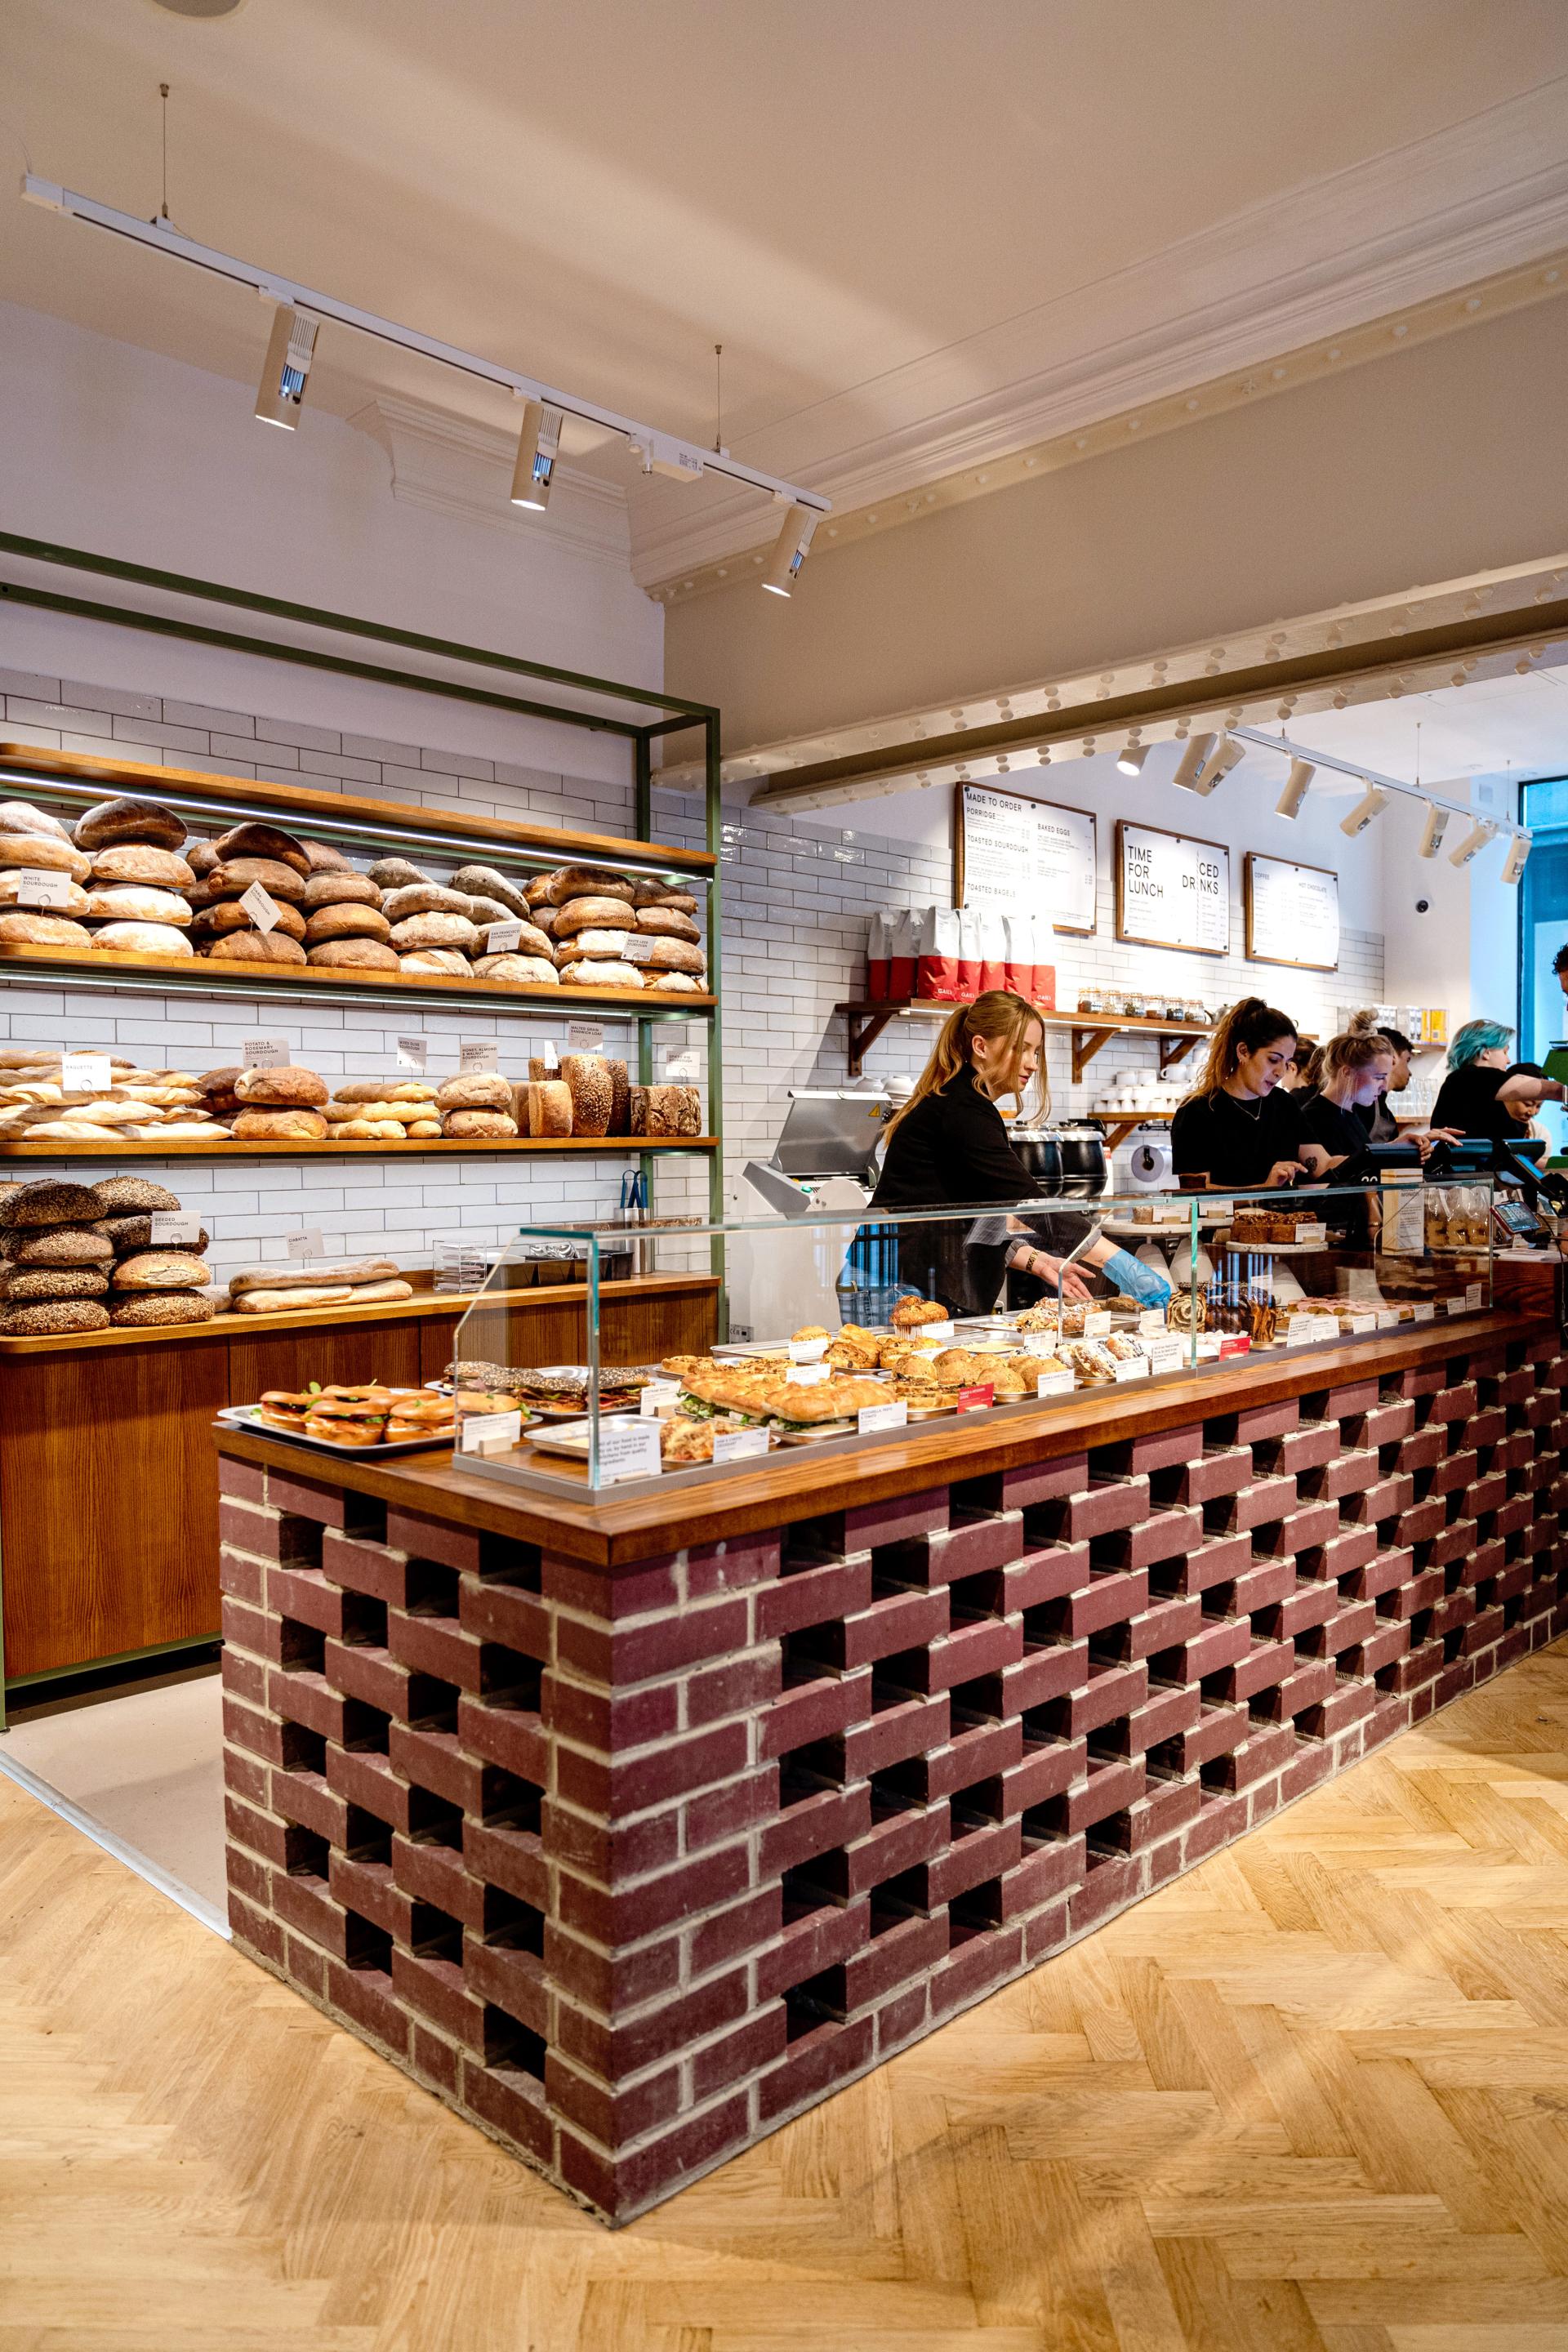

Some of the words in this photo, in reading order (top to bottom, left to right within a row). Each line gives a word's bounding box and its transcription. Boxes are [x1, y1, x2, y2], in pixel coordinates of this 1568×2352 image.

[966, 792, 986, 804] MADE
[988, 797, 997, 806] TO
[1000, 800, 1022, 813] ORDER
[966, 807, 996, 820] PORRIDGE
[1037, 823, 1055, 833] BAKED
[1056, 827, 1071, 836] EGGS
[967, 835, 992, 846] TOASTED
[994, 840, 1029, 853] SOURDOUGH
[1128, 845, 1152, 863] TIME
[1128, 862, 1150, 880] FOR
[1254, 872, 1270, 880] COFFEE
[967, 883, 992, 894] TOASTED
[994, 888, 1016, 898] BAGELS
[1129, 879, 1164, 898] LUNCH
